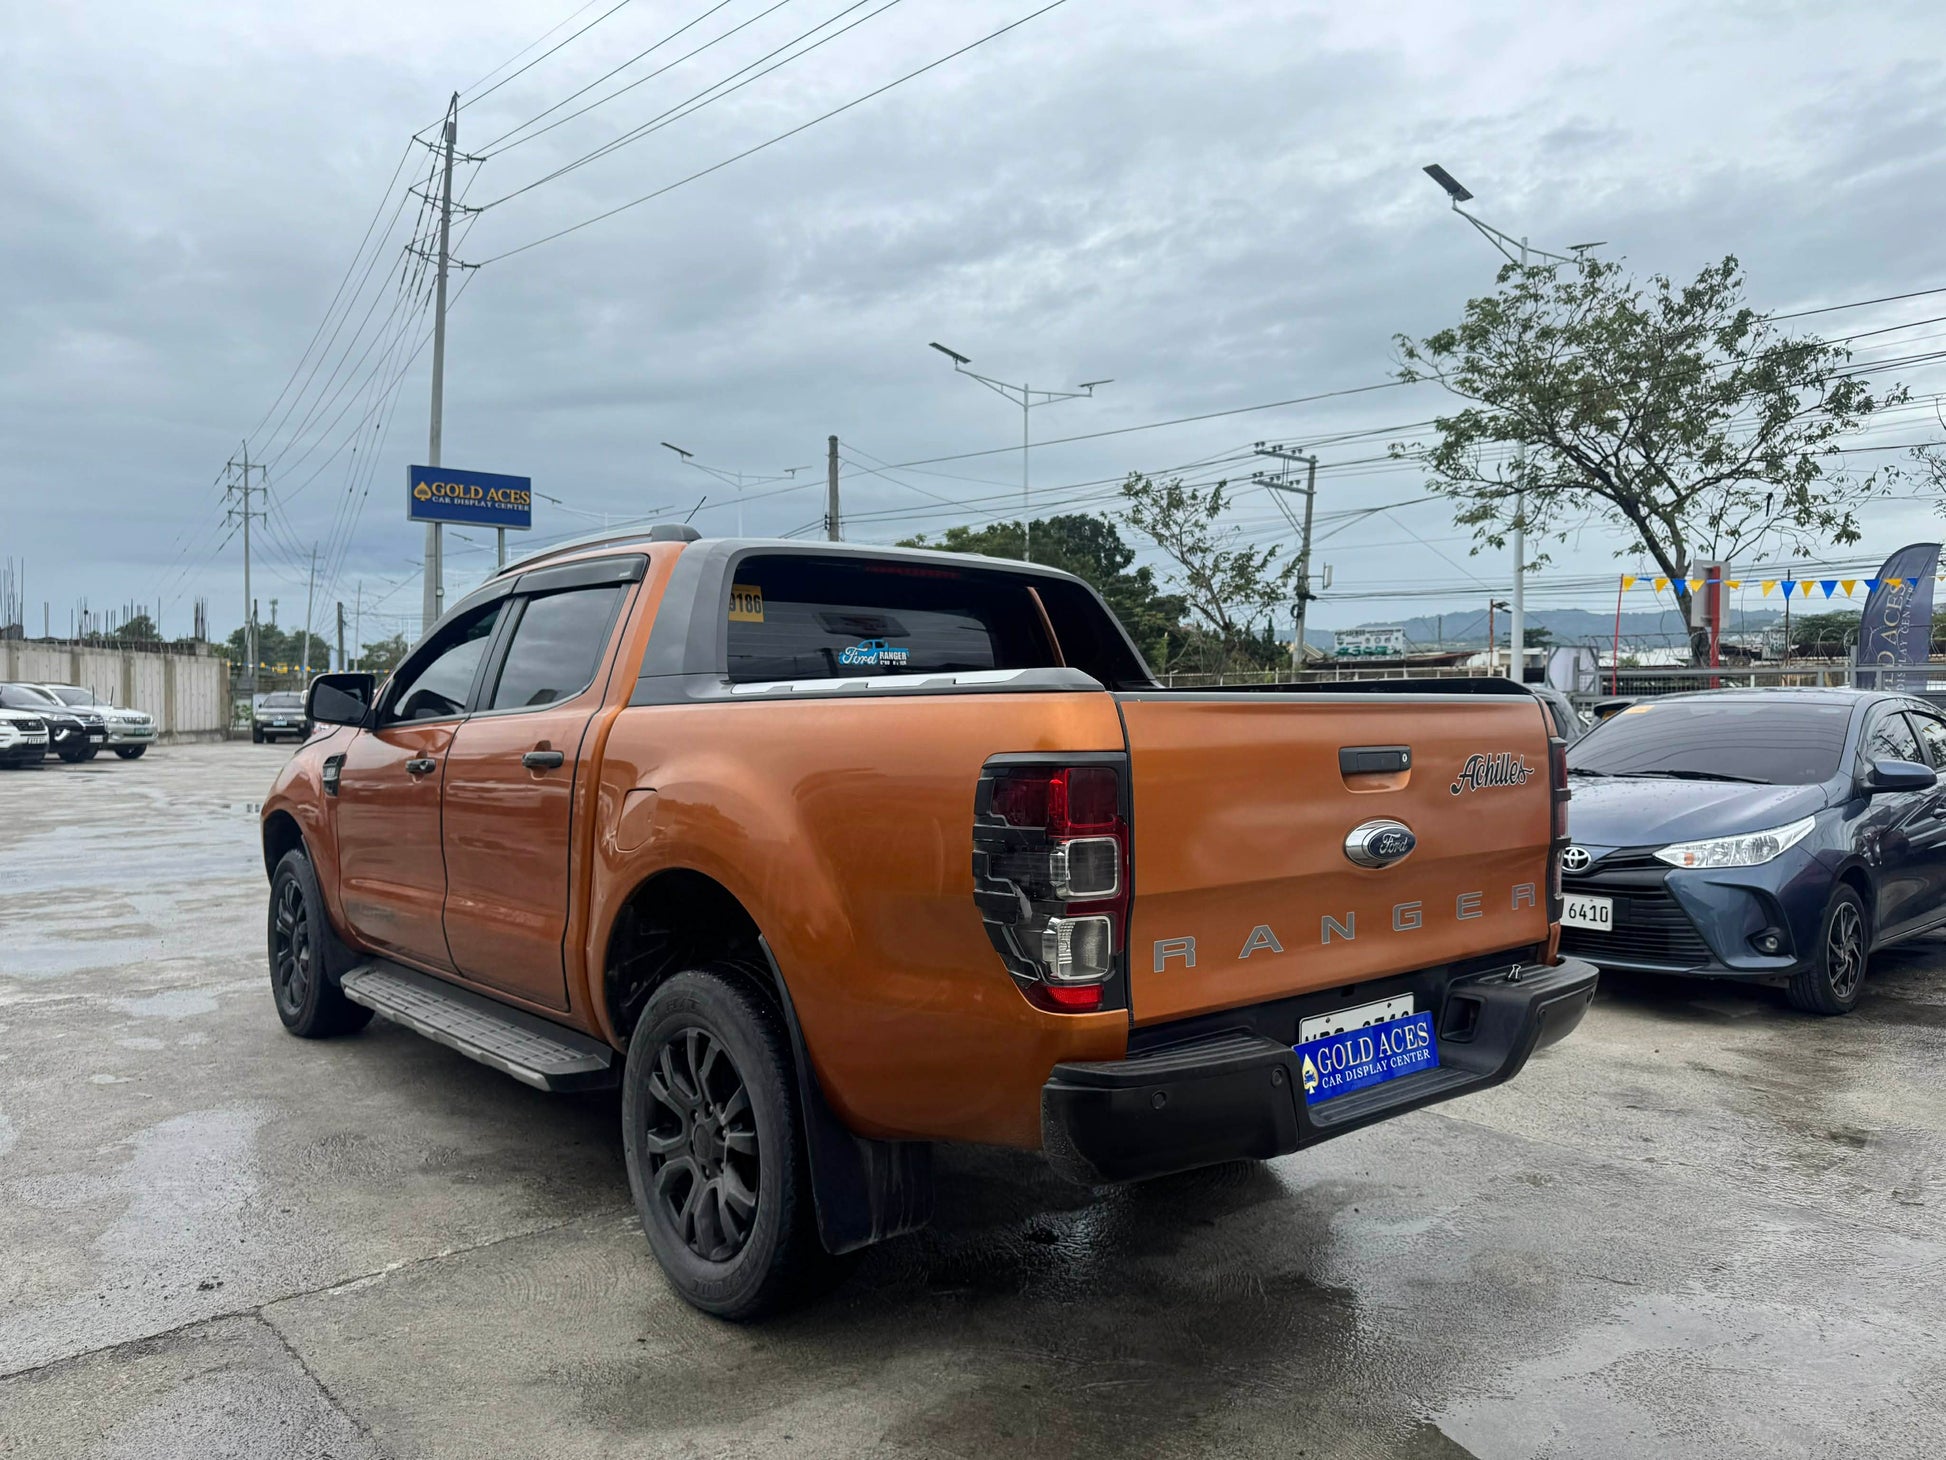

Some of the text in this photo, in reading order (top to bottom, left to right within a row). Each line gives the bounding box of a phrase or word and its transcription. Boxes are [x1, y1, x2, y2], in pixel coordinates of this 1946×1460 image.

[431, 482, 530, 505] GOLD ACES
[432, 496, 530, 512] CAR DISPLAY CENTER
[1880, 583, 1907, 646] ACES
[842, 646, 878, 665] Ford
[879, 651, 908, 660] RANGER
[1896, 641, 1908, 691] DISLAY
[1450, 752, 1534, 796] Achilles
[1379, 833, 1408, 855] Ford
[1153, 882, 1536, 973] RANGER
[1569, 903, 1608, 922] 6410
[1317, 1037, 1374, 1074] GOLD
[1378, 1022, 1430, 1058] ACES
[1322, 1048, 1431, 1089] CAR DISPLAY CENTER
